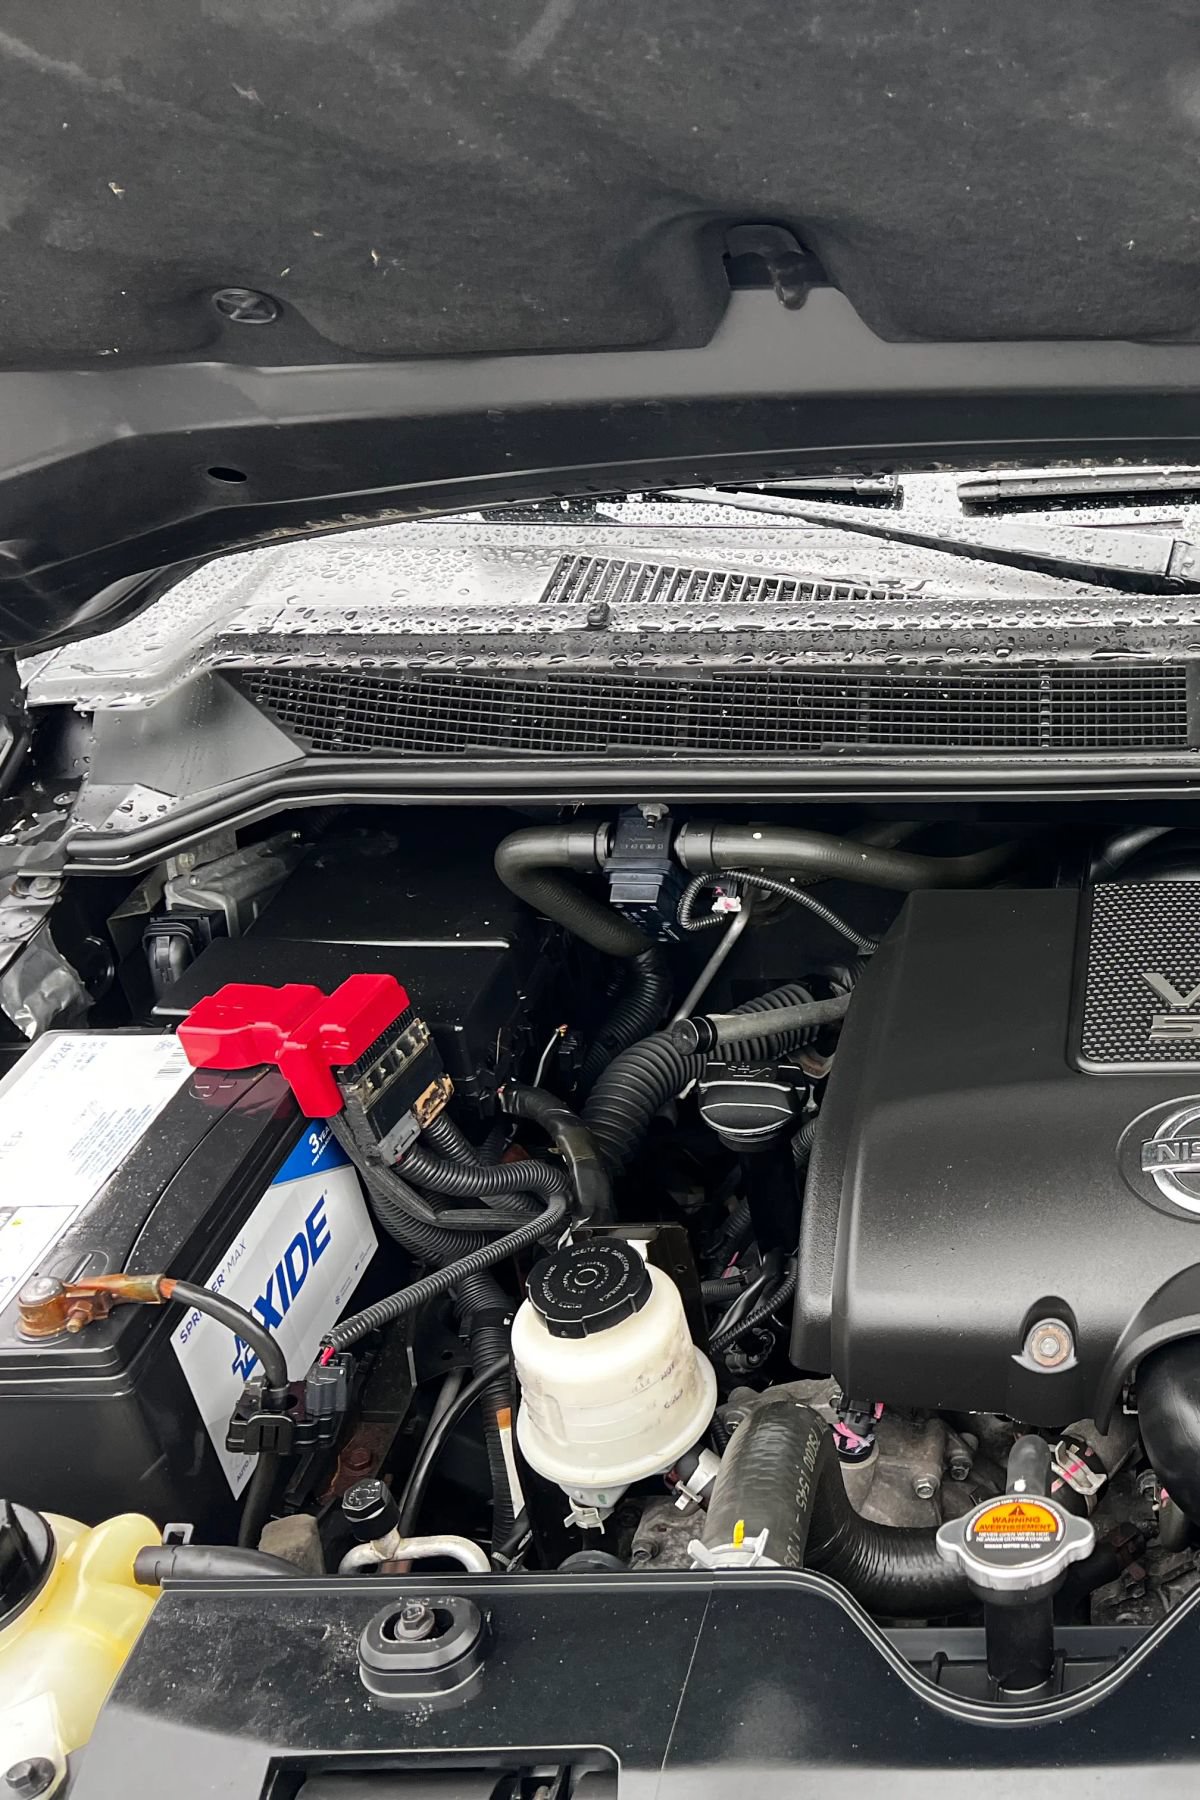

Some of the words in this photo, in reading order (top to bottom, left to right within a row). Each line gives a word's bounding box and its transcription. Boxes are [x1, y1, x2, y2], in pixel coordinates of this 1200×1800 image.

[309, 1133, 320, 1154] 3
[226, 1238, 248, 1274] MAX
[992, 1516, 1041, 1524] WARNING
